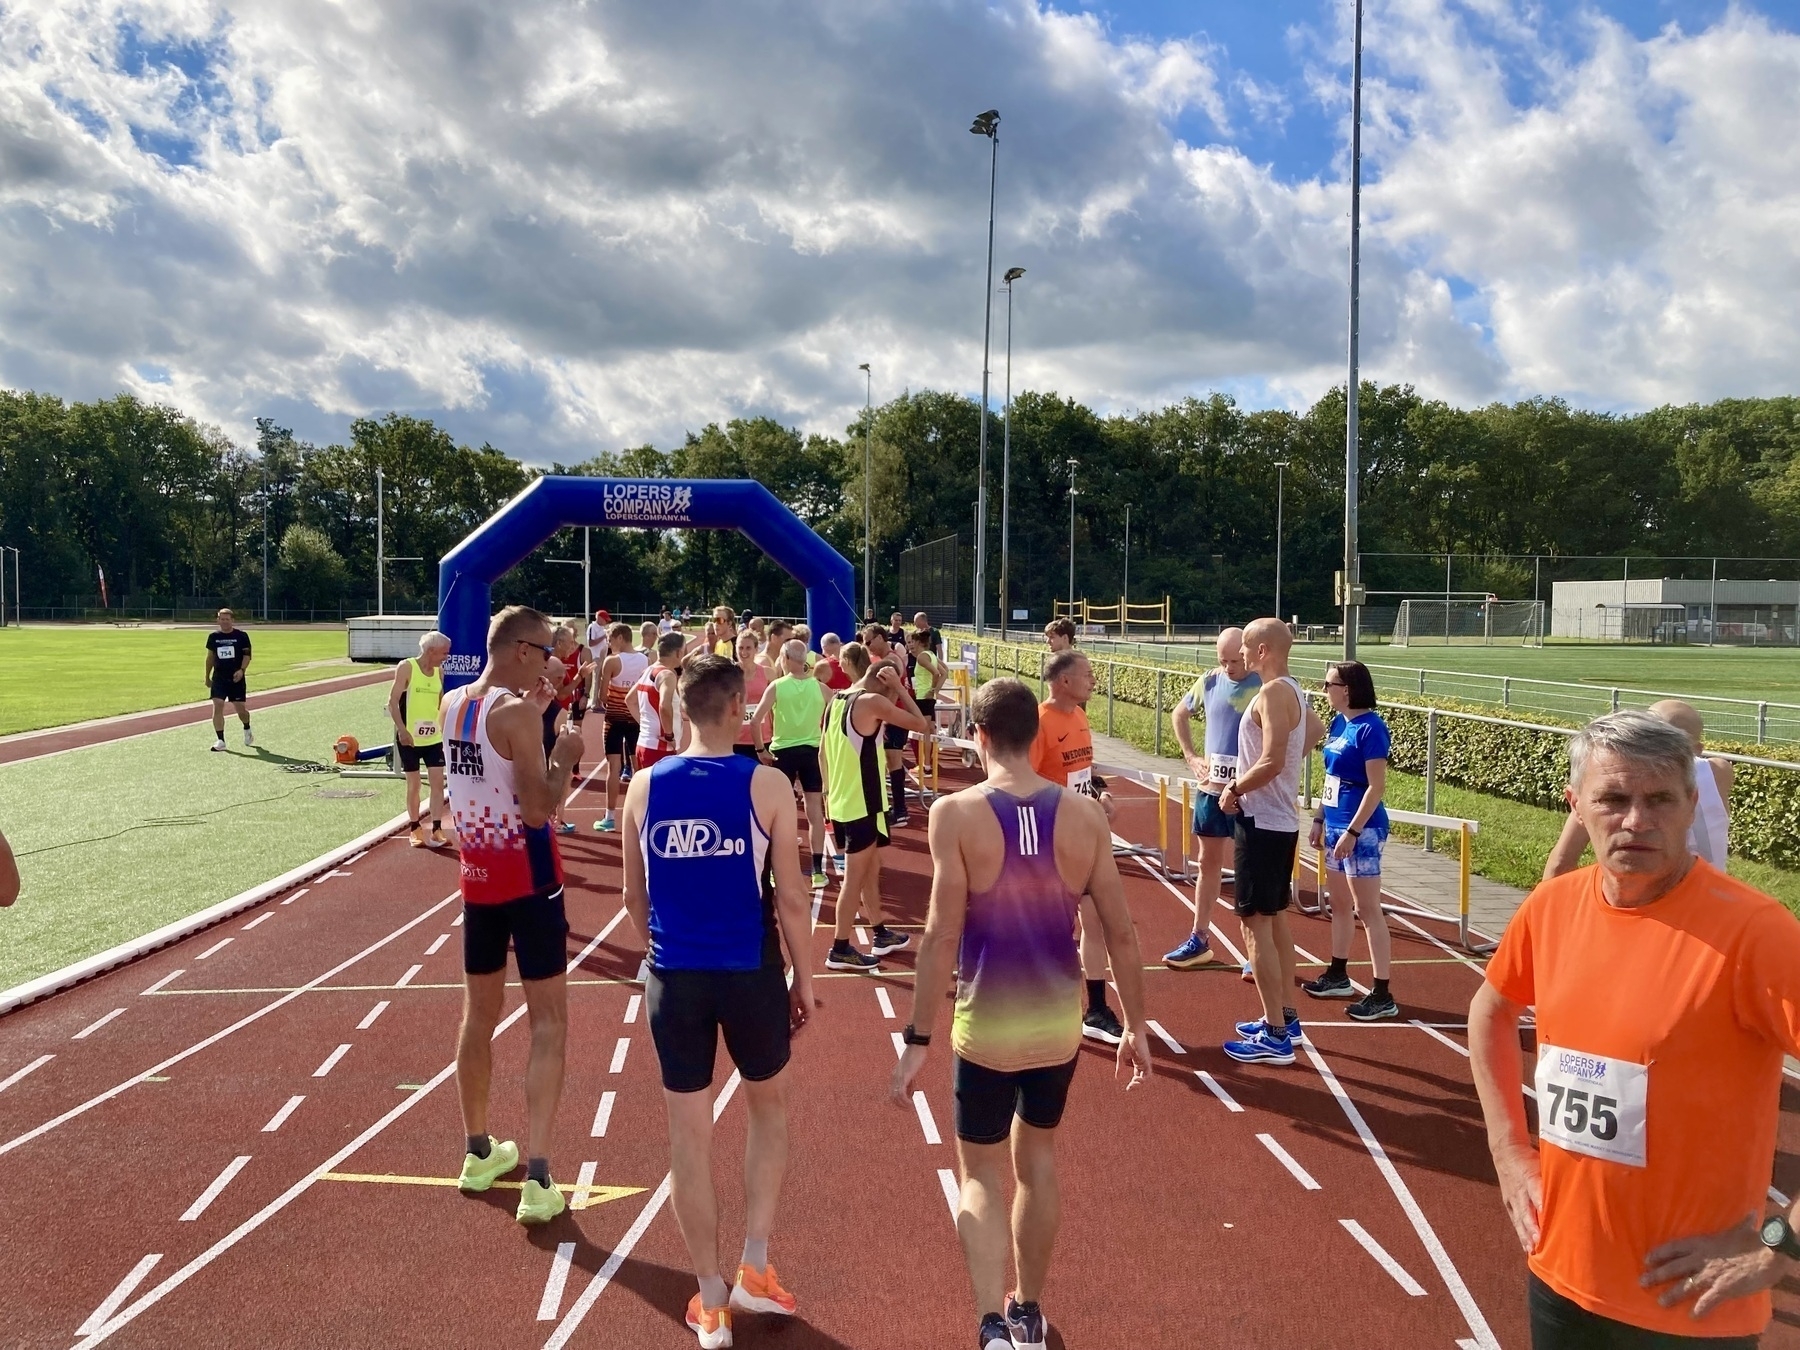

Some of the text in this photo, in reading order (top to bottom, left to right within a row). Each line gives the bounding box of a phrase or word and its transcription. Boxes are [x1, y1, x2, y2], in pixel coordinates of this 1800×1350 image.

[603, 484, 671, 500] LOPERS
[603, 499, 670, 514] COMPANY
[605, 513, 691, 521] LOPERSCOMPANY.NL
[418, 726, 436, 735] 679
[1560, 1053, 1595, 1069] LOPERS
[1559, 1063, 1594, 1078] COMPANY
[1547, 1083, 1618, 1141] 755
